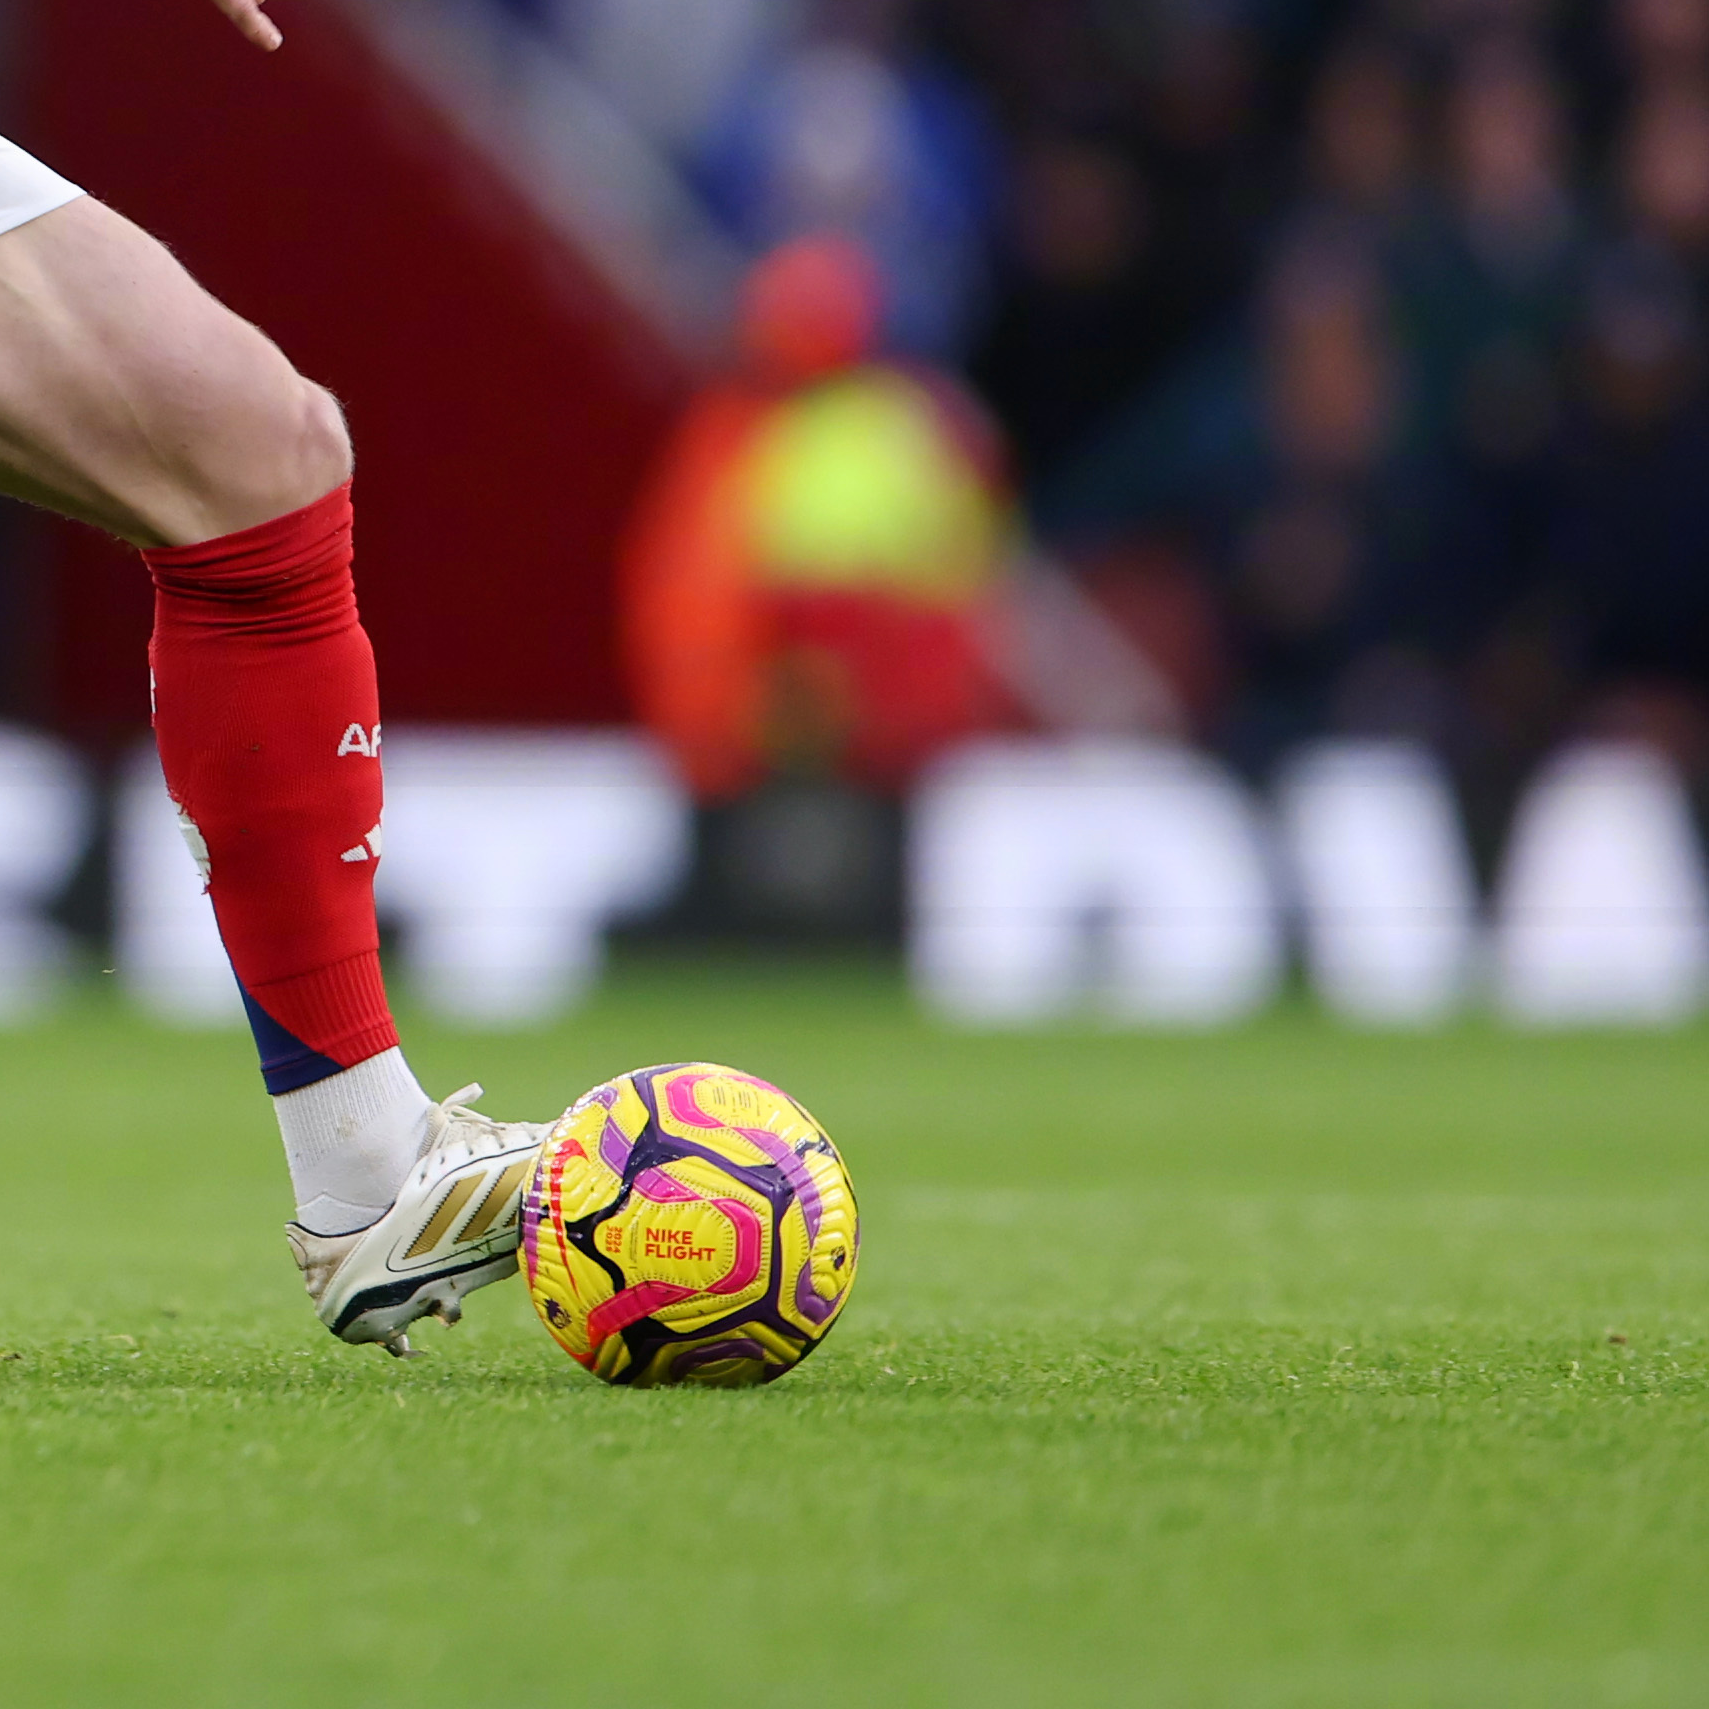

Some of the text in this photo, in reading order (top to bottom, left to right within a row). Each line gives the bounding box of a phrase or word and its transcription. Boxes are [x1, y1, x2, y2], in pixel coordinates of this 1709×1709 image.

[613, 1226, 623, 1254] 2024
[645, 1227, 693, 1245] NIKE
[644, 1243, 716, 1262] FLIGHT
